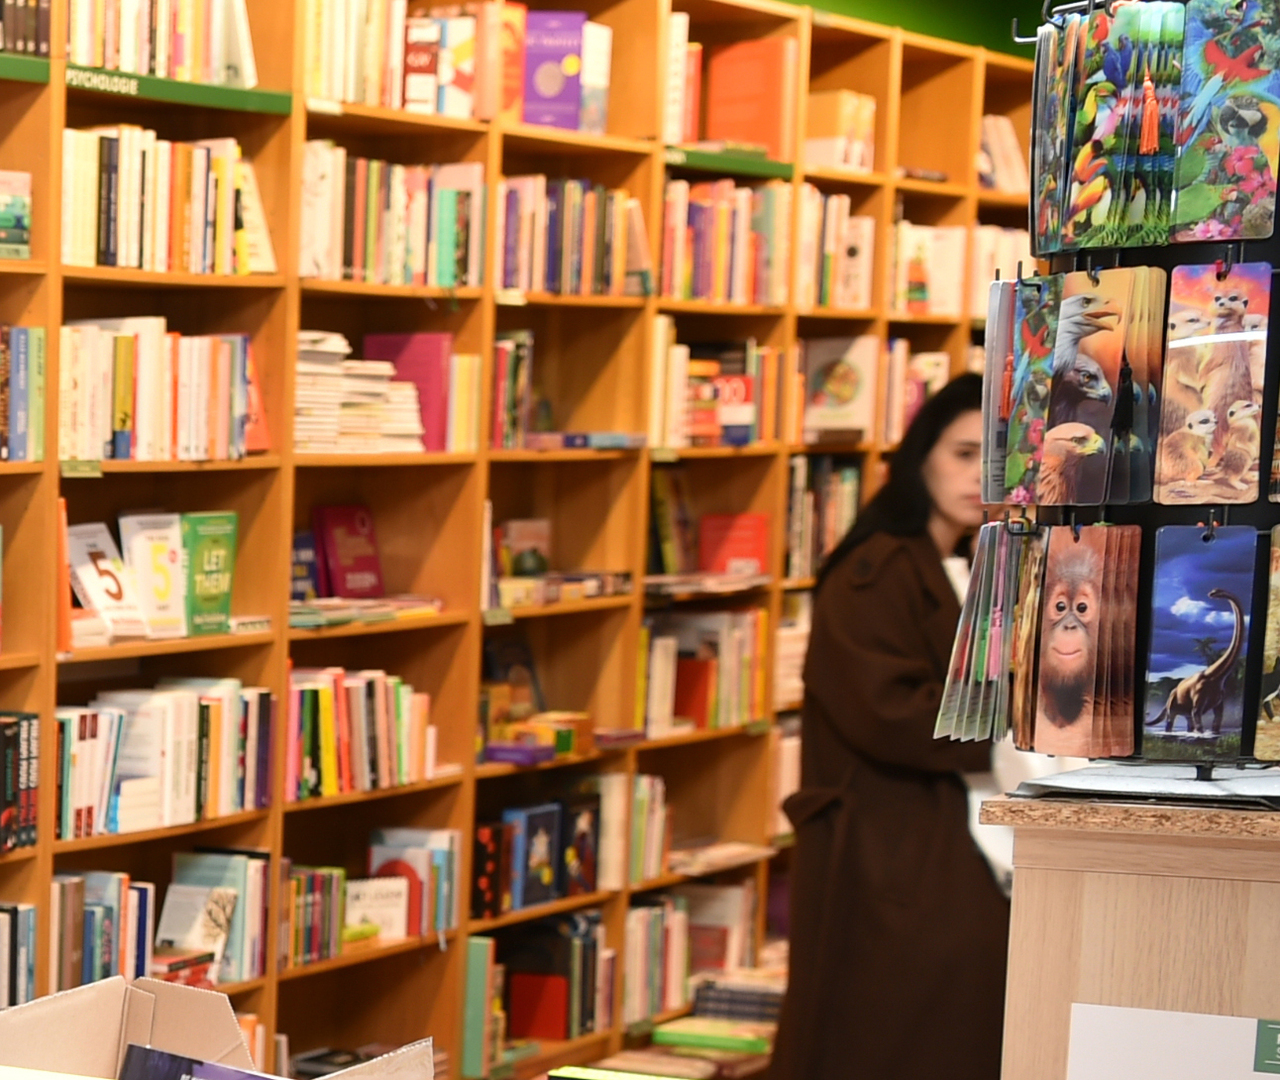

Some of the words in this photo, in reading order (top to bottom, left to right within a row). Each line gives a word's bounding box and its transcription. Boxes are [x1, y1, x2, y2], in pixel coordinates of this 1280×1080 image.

[66, 69, 138, 95] PSYCHOLOGIE
[203, 550, 226, 570] LET
[195, 573, 231, 595] THEM
